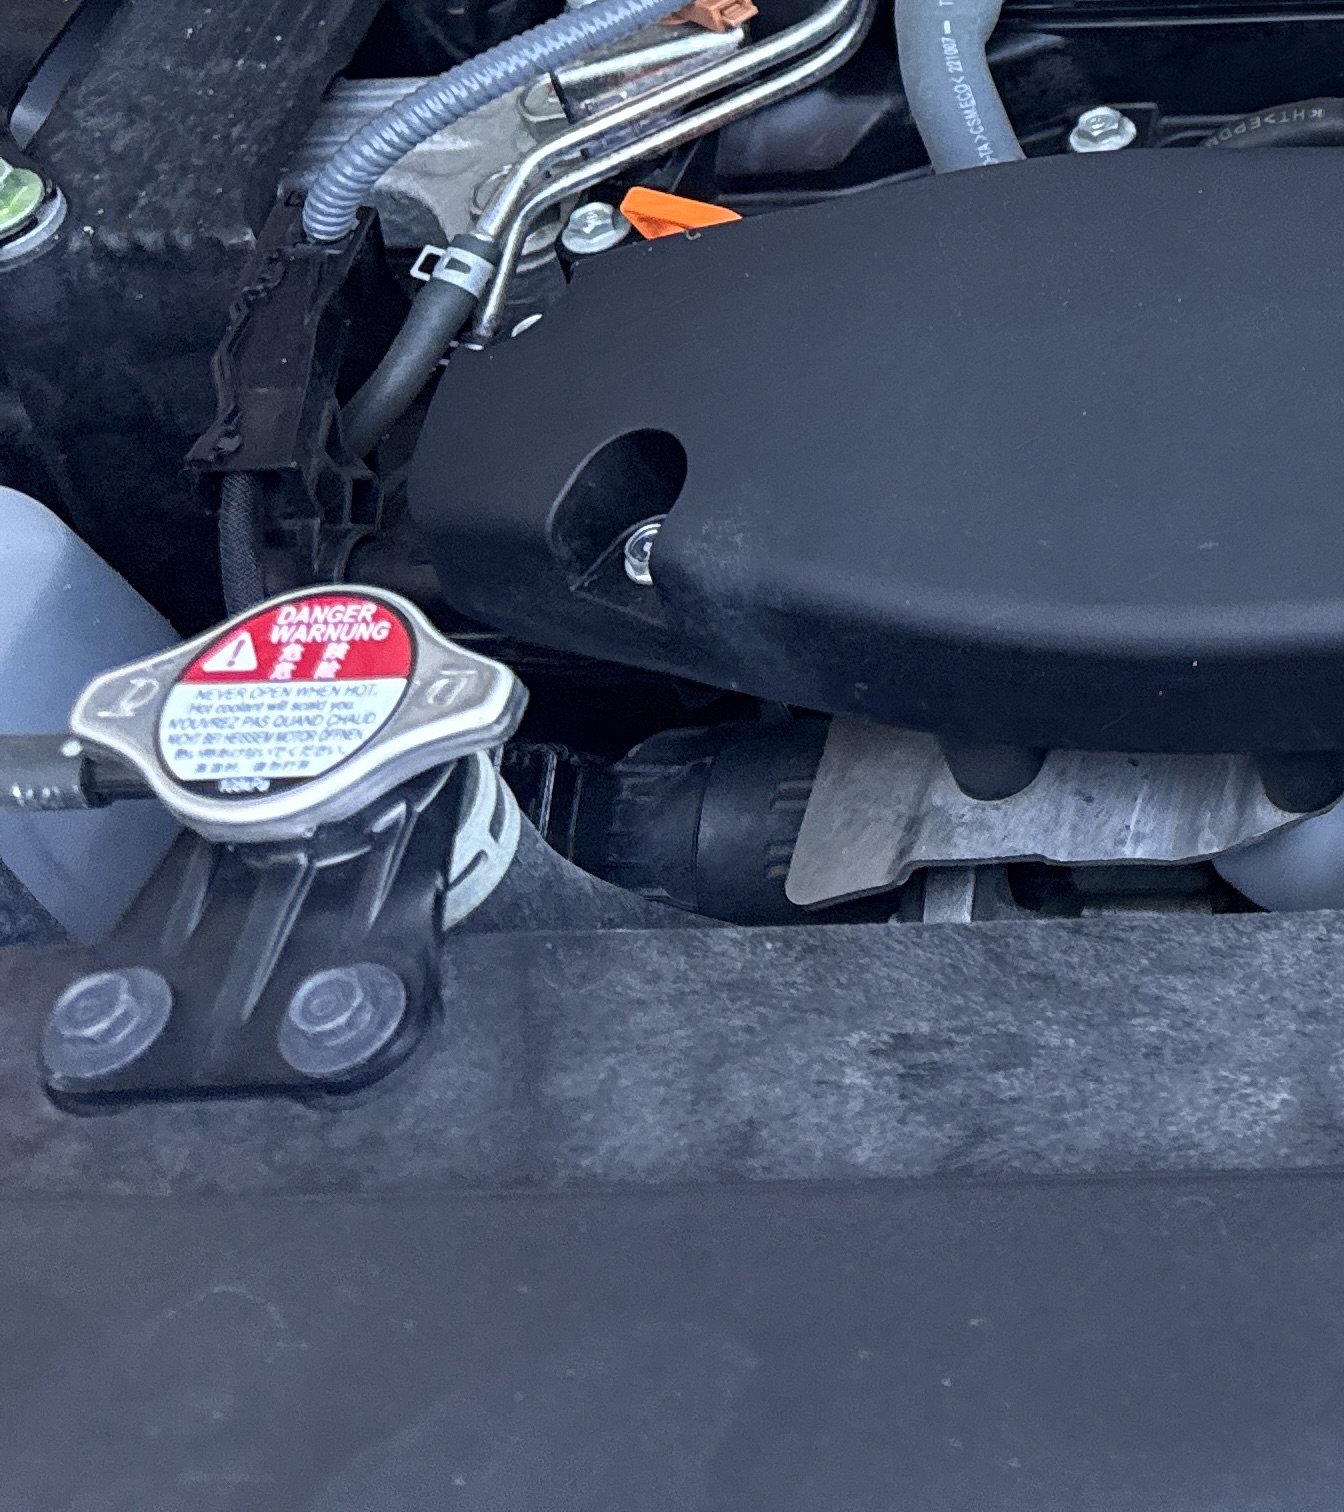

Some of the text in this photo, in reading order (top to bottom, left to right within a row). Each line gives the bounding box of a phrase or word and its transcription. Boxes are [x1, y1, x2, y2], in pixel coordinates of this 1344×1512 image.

[277, 603, 377, 625] DANGER
[270, 621, 391, 643] WARNUNG
[195, 688, 246, 701] NEVER
[249, 686, 290, 700] OPEN
[295, 685, 340, 698] WHEN
[272, 715, 324, 727] QUAND
